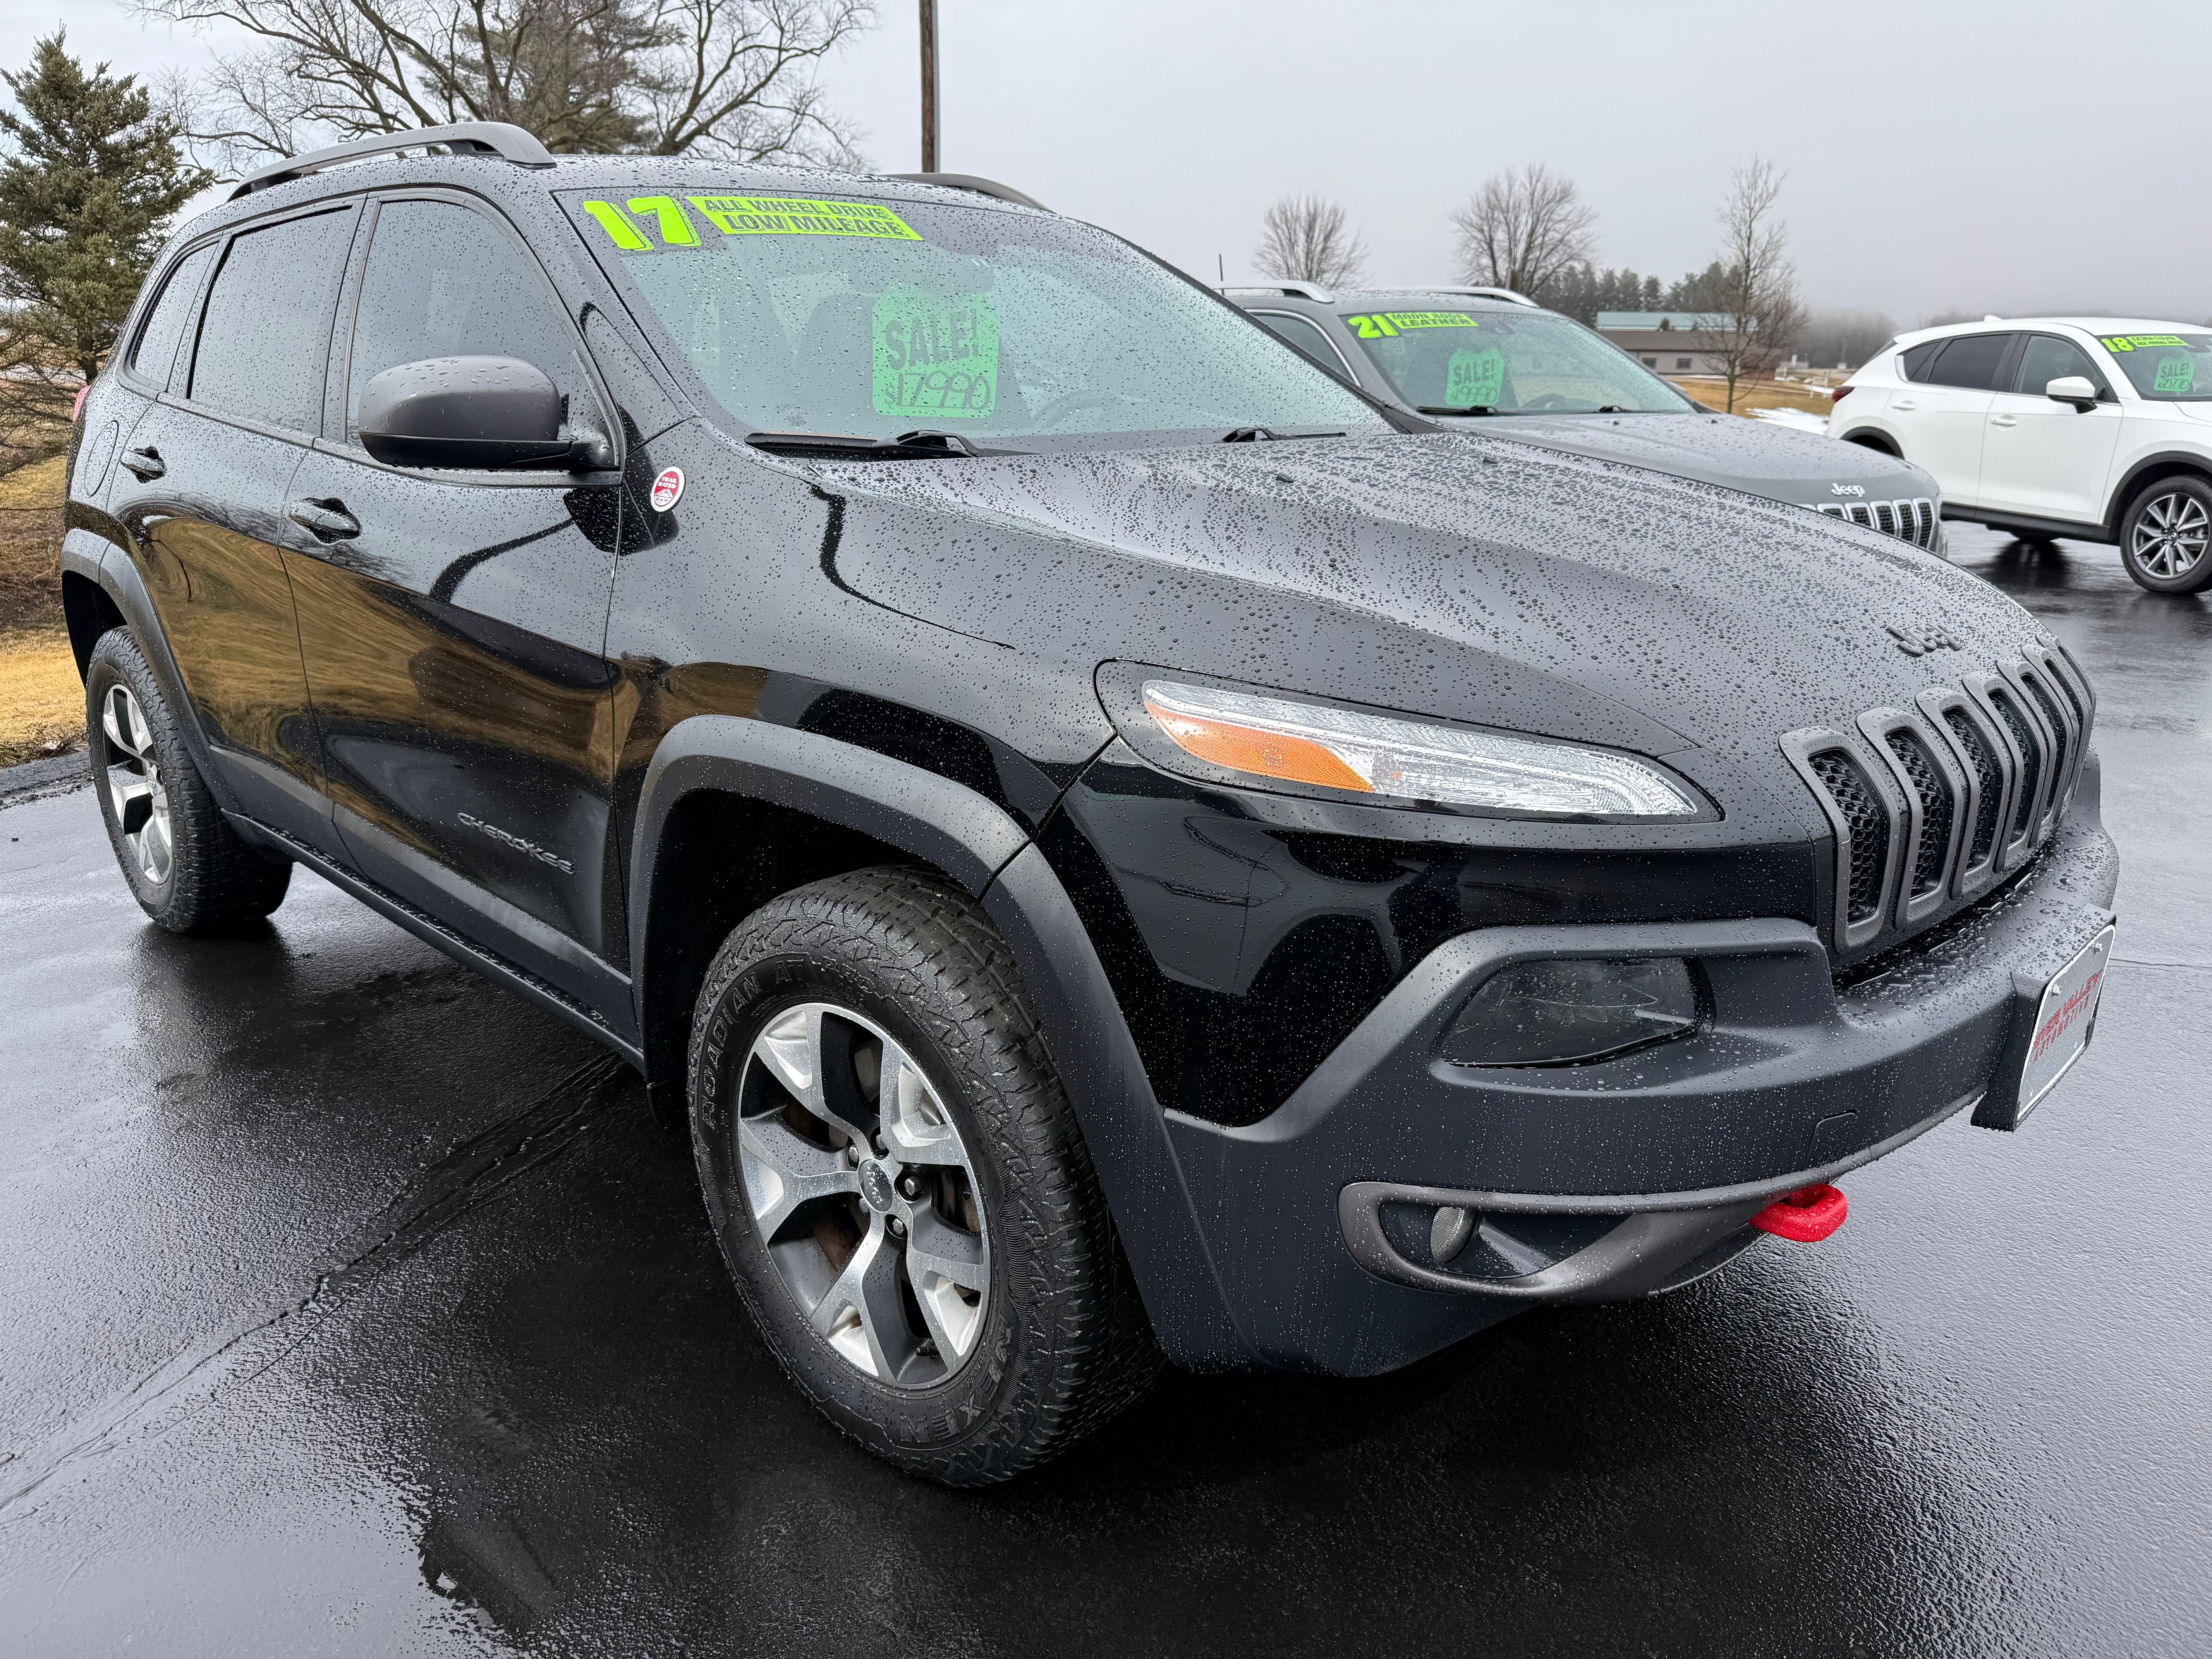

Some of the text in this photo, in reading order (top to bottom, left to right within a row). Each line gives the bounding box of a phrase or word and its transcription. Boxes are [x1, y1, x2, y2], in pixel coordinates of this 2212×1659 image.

[582, 196, 702, 251] 17
[704, 199, 891, 221] ALL WHEEL DRIVE
[723, 214, 908, 237] LOW MILEAGE
[885, 310, 979, 370] SALE!
[1348, 315, 1398, 338] 21
[2101, 337, 2134, 352] 18
[1453, 359, 1495, 386] SALE!
[2160, 362, 2190, 379] SALE!
[885, 370, 991, 410] $17990
[1831, 483, 1865, 498] Jeep
[1885, 623, 1962, 657] Jeep
[457, 812, 576, 875] CHEROKEE
[2063, 968, 2103, 1017] VALLEY
[701, 971, 764, 1132] ROADIAN
[775, 960, 805, 985] AT
[820, 955, 876, 994] PRO
[898, 1312, 1014, 1444] NEXEN
